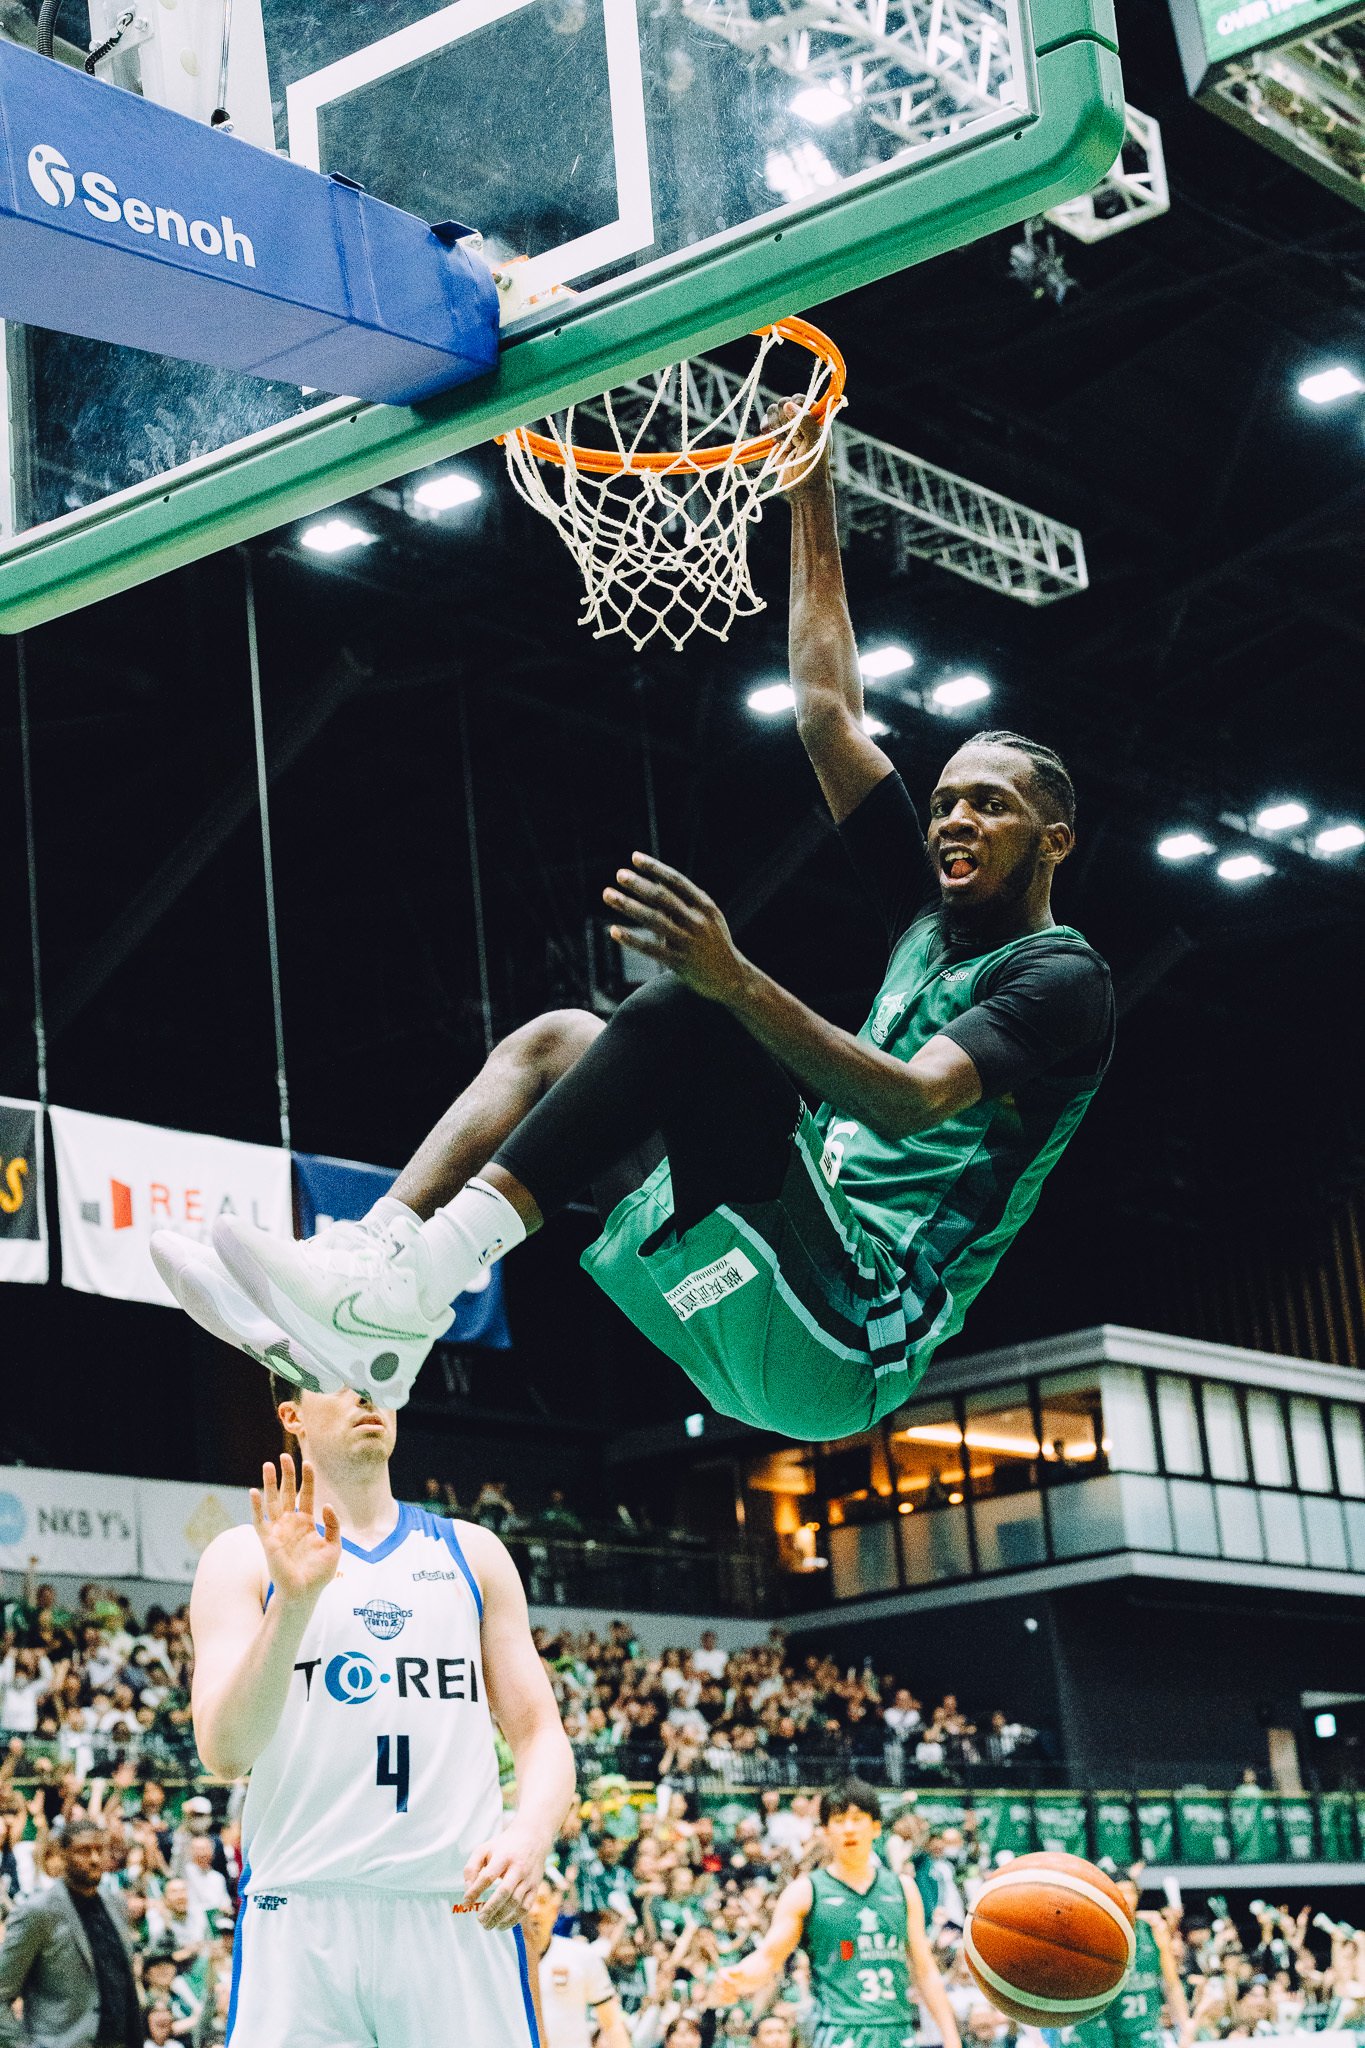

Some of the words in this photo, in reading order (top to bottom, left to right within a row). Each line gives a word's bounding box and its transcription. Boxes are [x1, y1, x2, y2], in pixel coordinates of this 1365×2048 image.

[82, 171, 256, 268] Senoh
[149, 1183, 270, 1232] REAL
[691, 1259, 730, 1283] YOKOHAMA
[352, 1608, 413, 1620] EARTHFRIENDS
[367, 1618, 389, 1627] TOKYO
[376, 1734, 410, 1814] 4
[1120, 1993, 1148, 2019] 21
